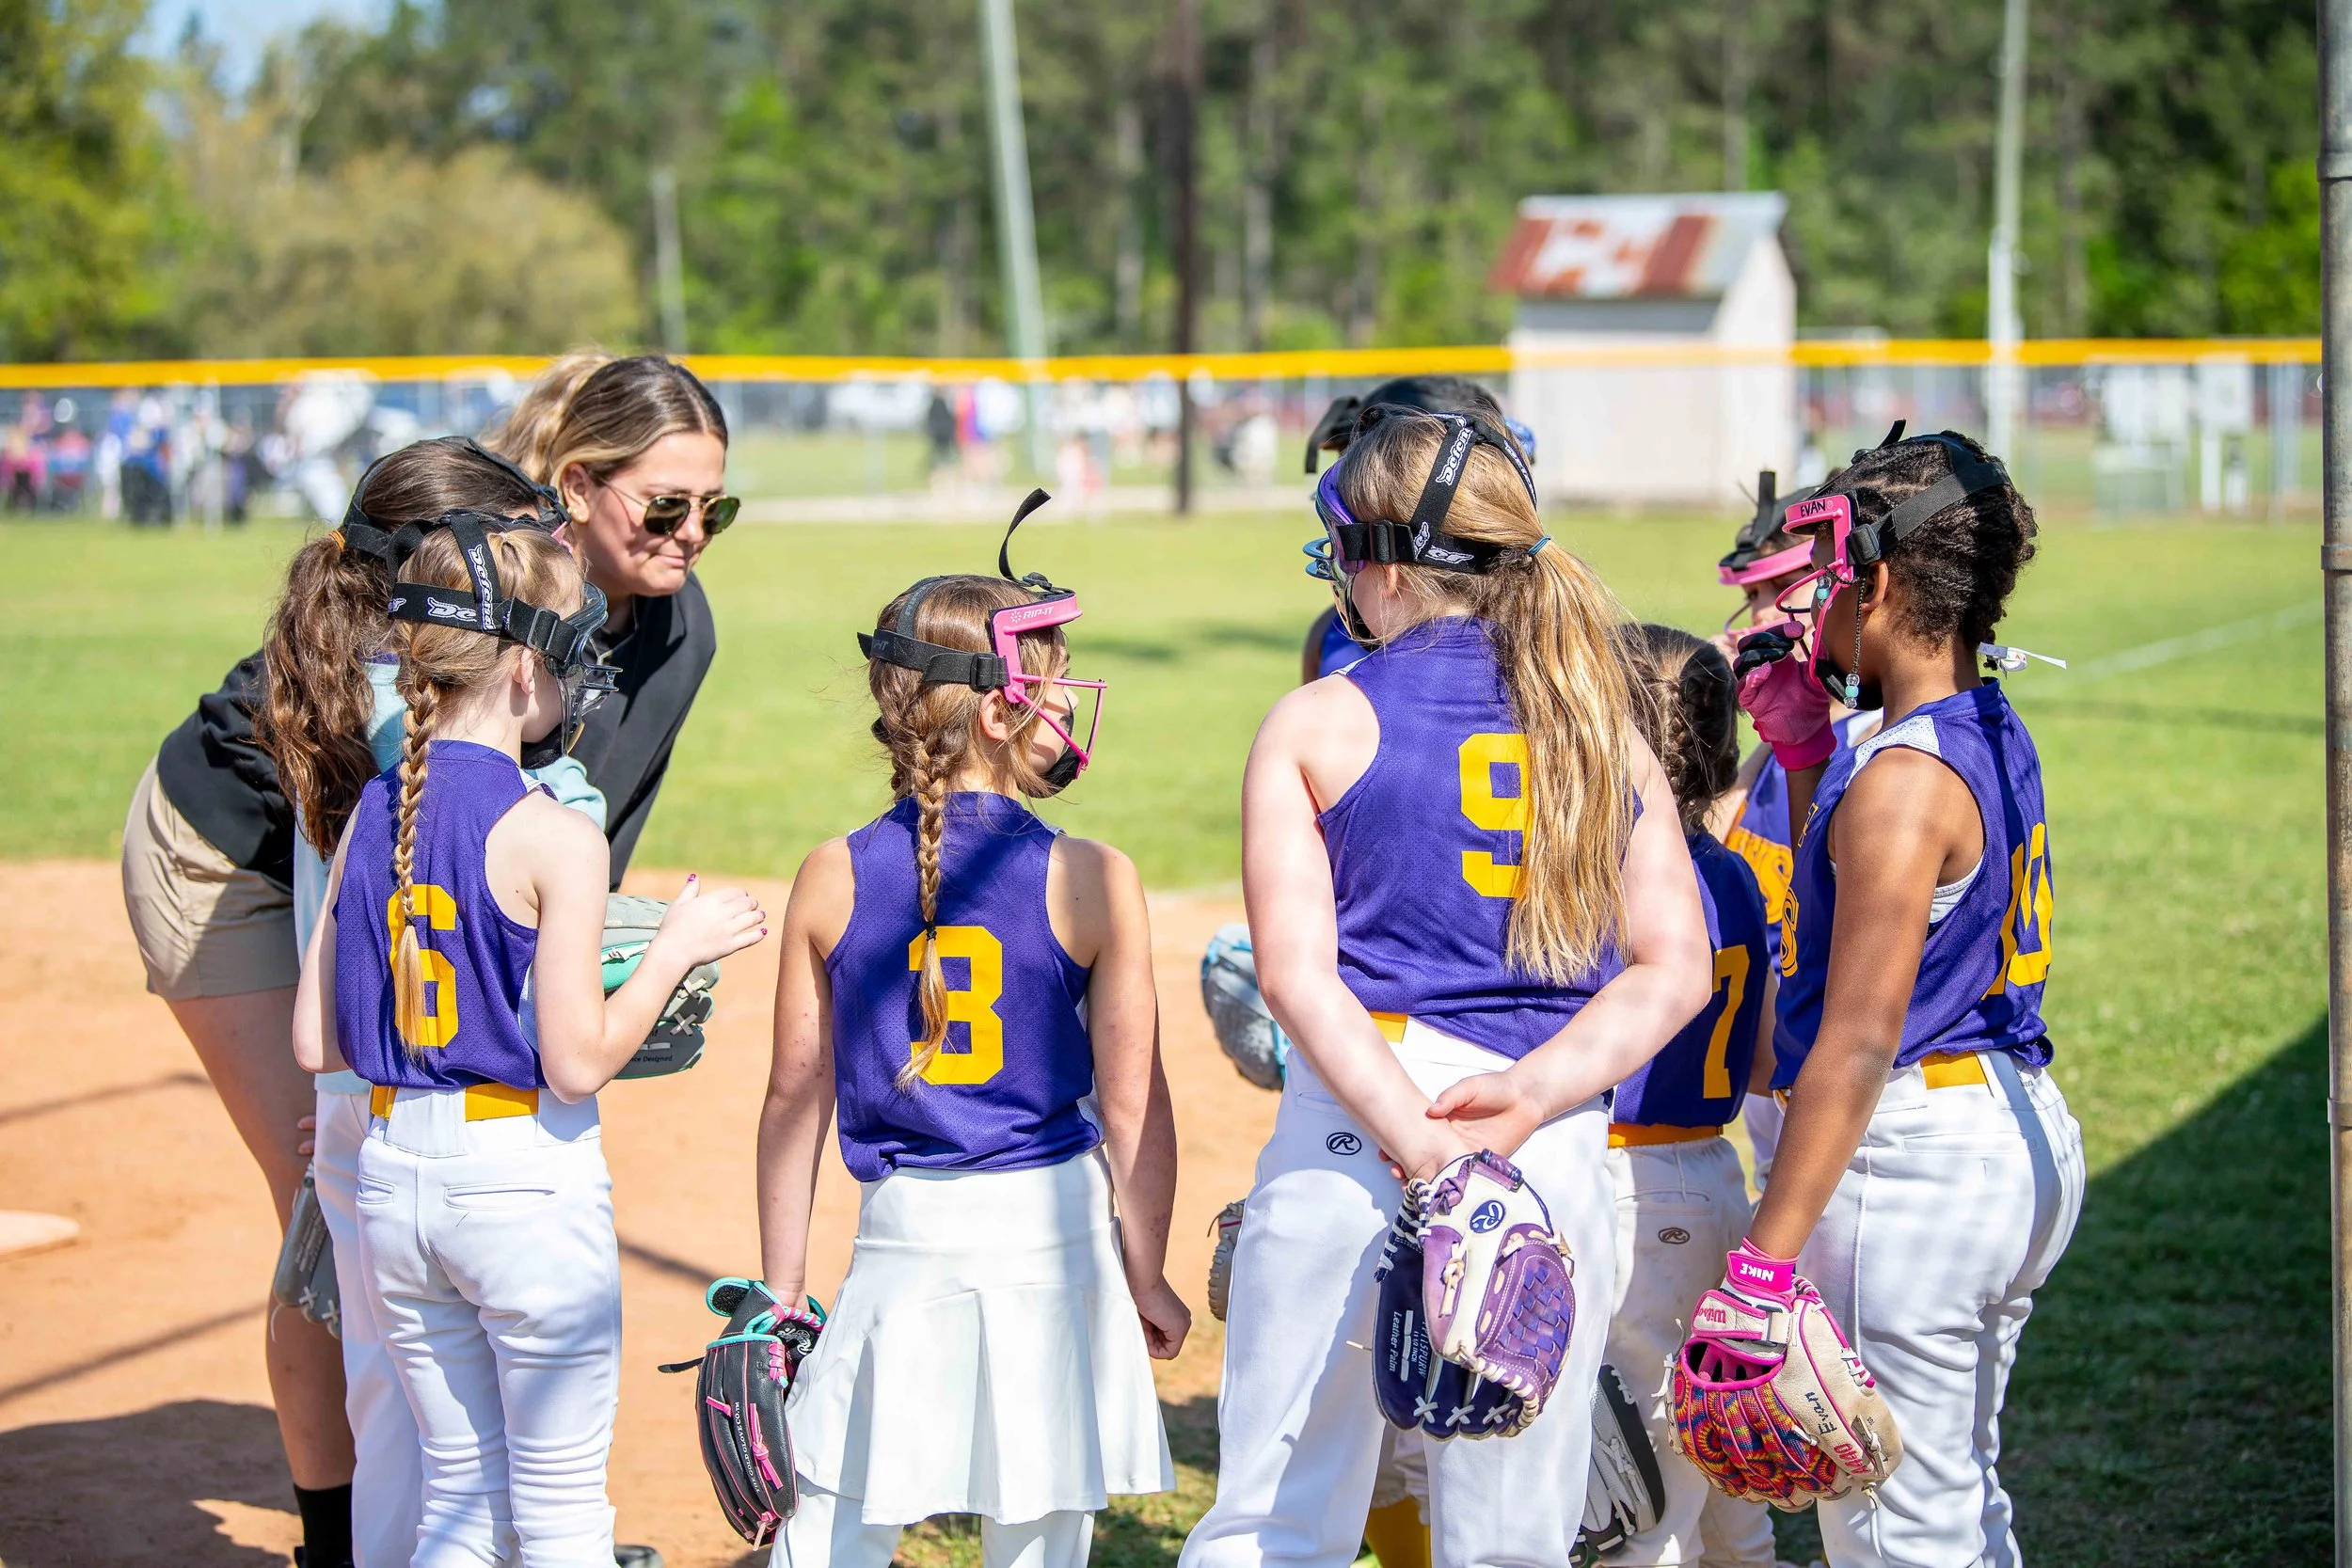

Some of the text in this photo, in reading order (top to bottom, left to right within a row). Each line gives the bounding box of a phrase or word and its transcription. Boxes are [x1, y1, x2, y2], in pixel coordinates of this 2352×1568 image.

[1800, 499, 1826, 518] EVAN
[1023, 606, 1054, 620] RIP-IT
[1458, 732, 1534, 899] 9
[388, 883, 459, 1049] 6
[908, 926, 1004, 1085] 3
[1703, 943, 1751, 1100] 7
[643, 1054, 674, 1064] Designed
[1740, 1262, 1775, 1282] NIKE
[1698, 1307, 1726, 1324] Wilso
[1389, 1311, 1402, 1372] Leather Palm
[1804, 1391, 1837, 1435] Evan
[737, 1424, 748, 1452] GLOVE
[744, 1454, 754, 1476] GOLD
